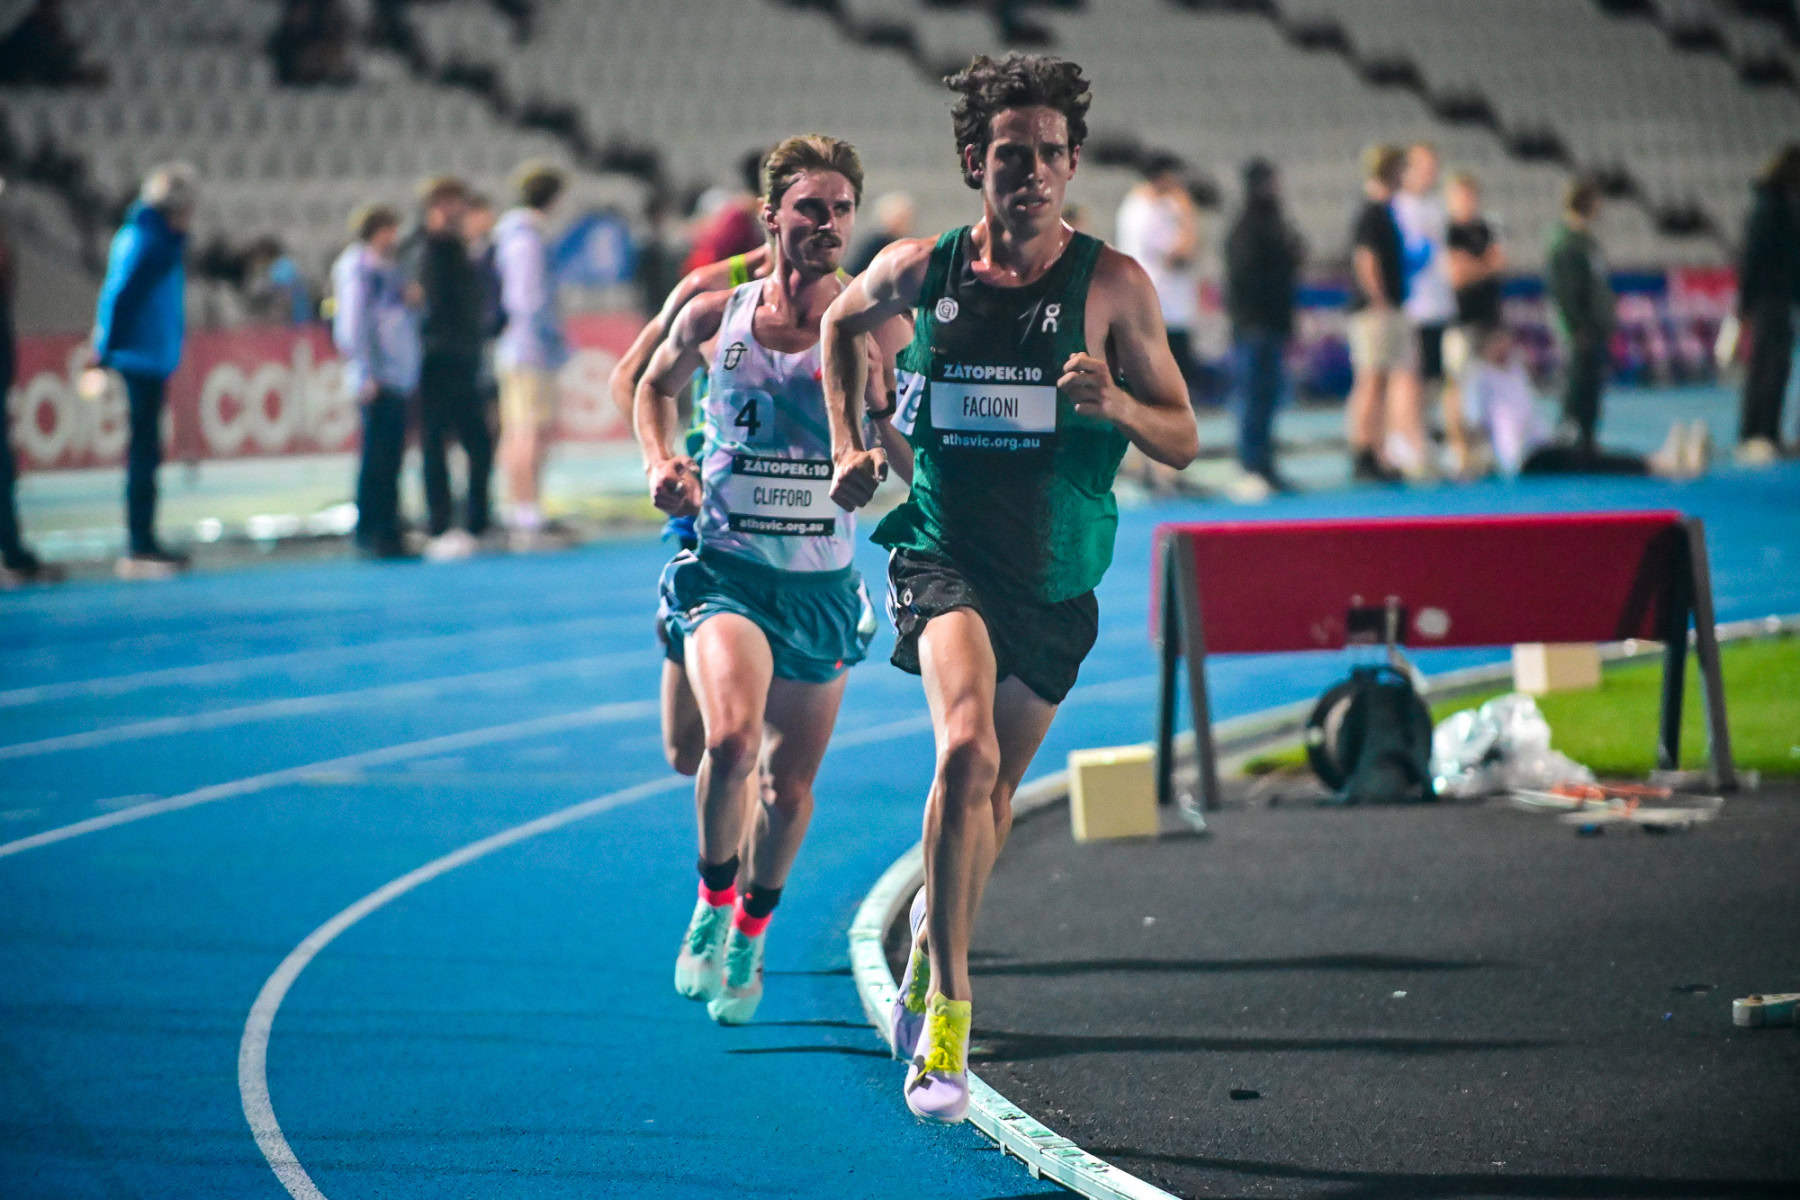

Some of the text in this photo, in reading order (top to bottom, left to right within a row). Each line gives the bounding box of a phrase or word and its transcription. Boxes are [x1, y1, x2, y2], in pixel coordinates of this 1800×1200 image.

[734, 398, 762, 436] 4
[962, 395, 1019, 418] FACIONI
[942, 432, 1041, 450] athsvic.org.au
[753, 486, 812, 507] CLIFFORD
[739, 517, 825, 534] athsvic.org.au
